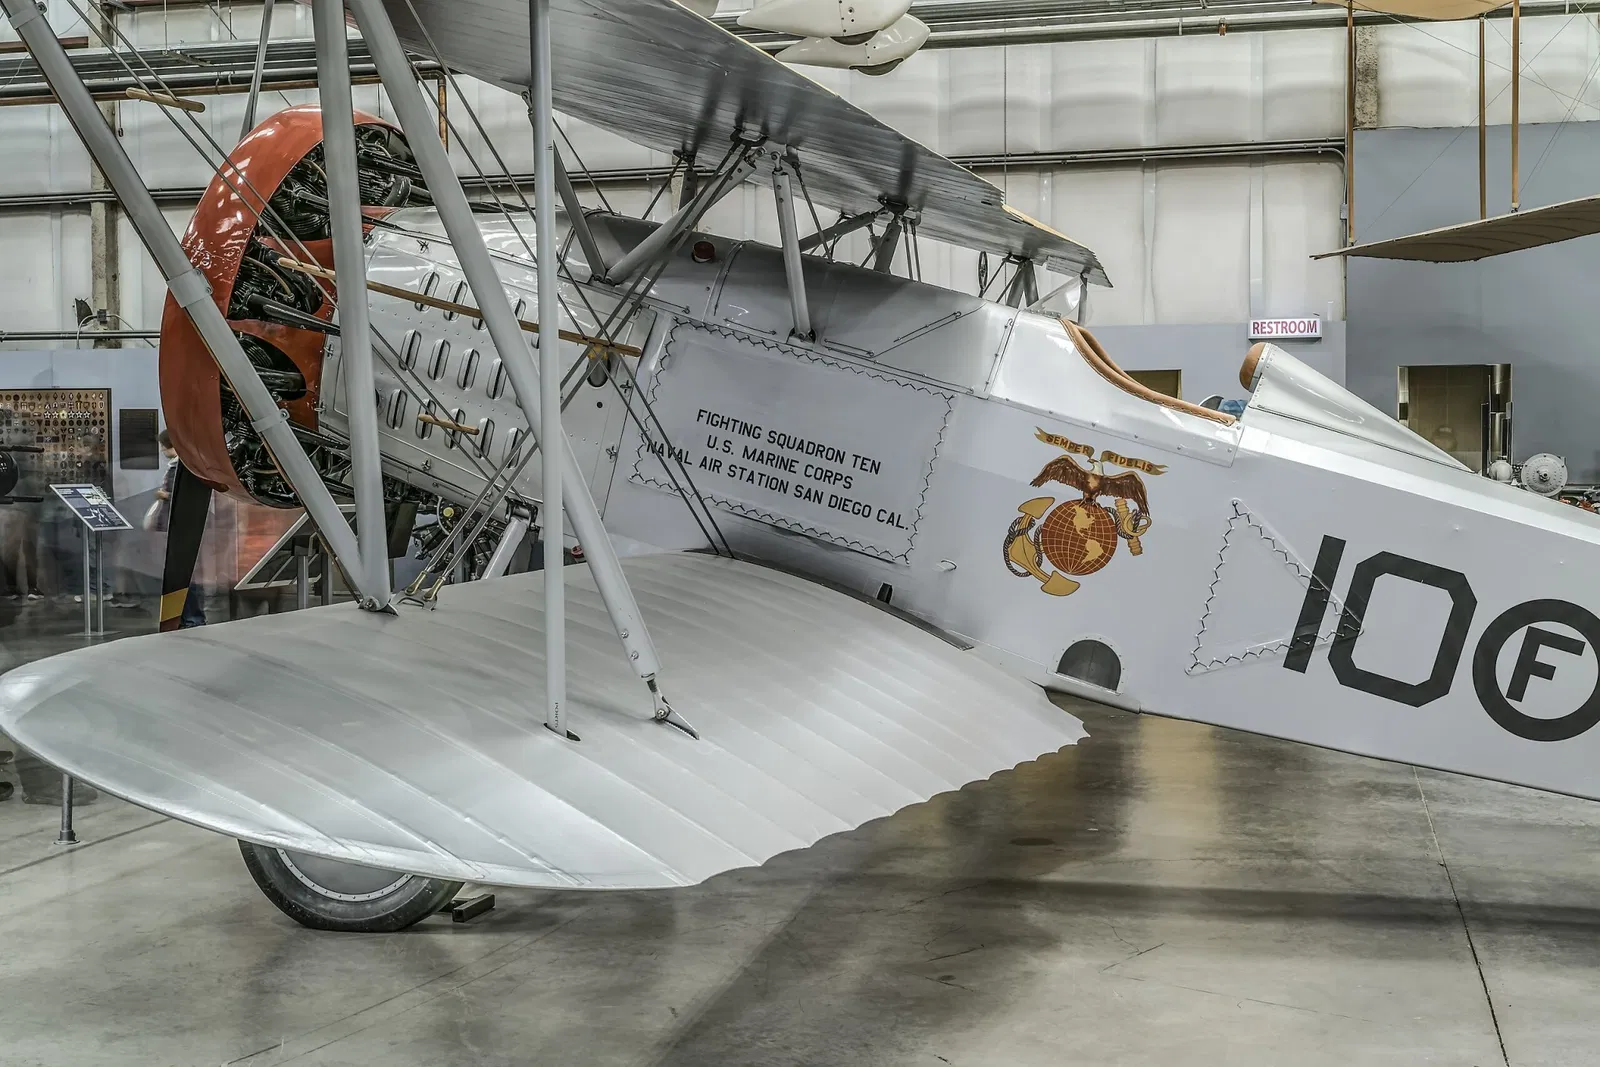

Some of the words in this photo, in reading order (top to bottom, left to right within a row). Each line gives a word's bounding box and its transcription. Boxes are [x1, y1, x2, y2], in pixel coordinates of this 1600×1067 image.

[1252, 320, 1317, 334] RESTROOM
[696, 409, 762, 440] FIGHTING
[767, 430, 846, 464] SQUADRON
[852, 454, 881, 475] TEN
[707, 435, 734, 456] U.S.
[742, 445, 799, 474] MARINE
[804, 464, 853, 489] CORPS
[1045, 434, 1090, 455] SEMPER
[1107, 453, 1154, 472] FIDELIS
[699, 456, 723, 475] AIR
[727, 464, 788, 494] STATION
[793, 485, 824, 505] SAN
[828, 494, 872, 518] DIEGO
[876, 508, 909, 530] CAL.
[1283, 534, 1478, 708] 10
[1505, 625, 1586, 703] F
